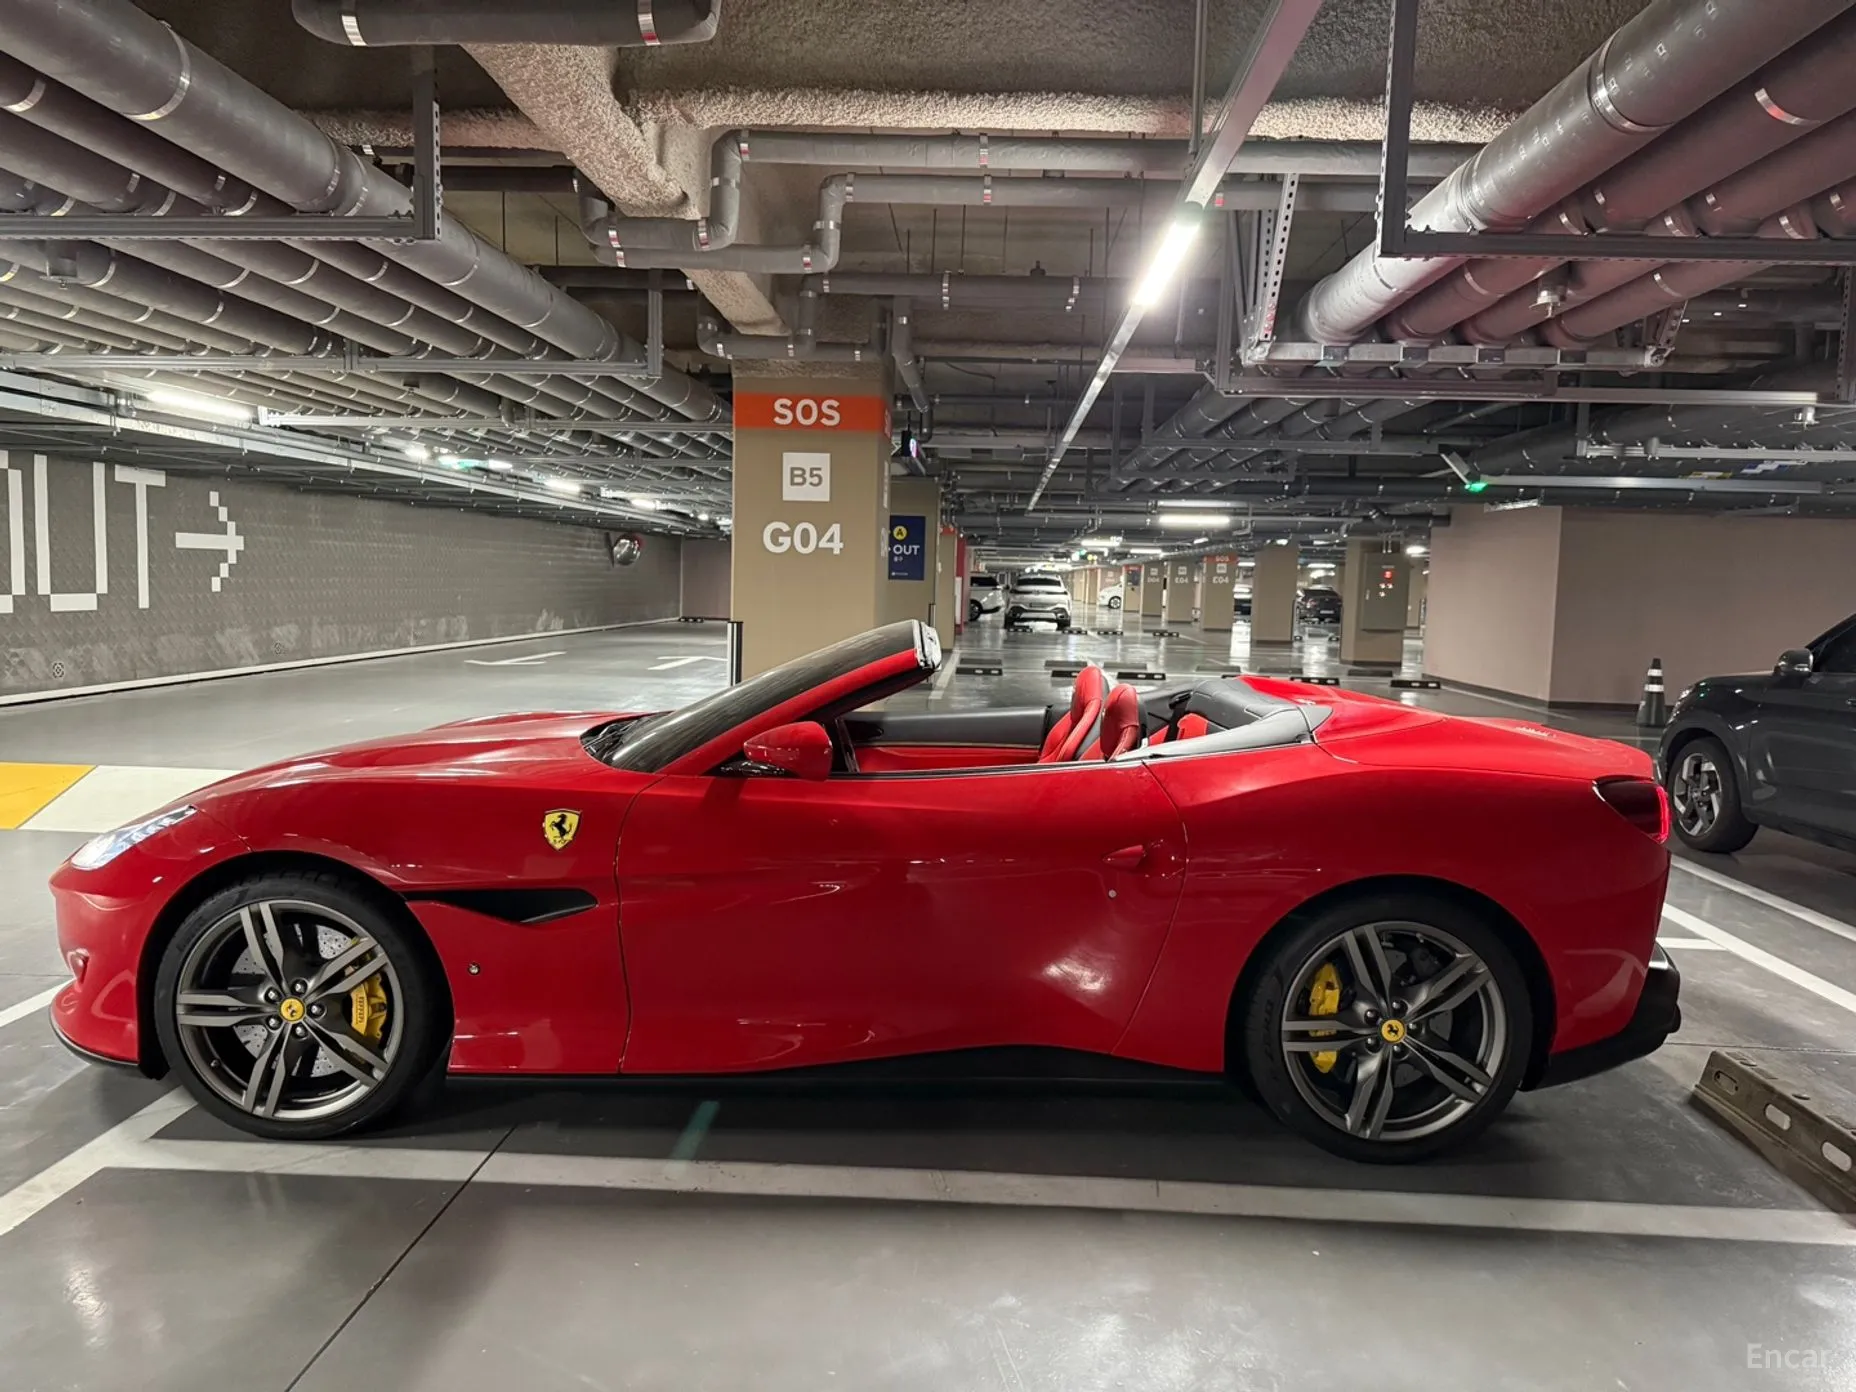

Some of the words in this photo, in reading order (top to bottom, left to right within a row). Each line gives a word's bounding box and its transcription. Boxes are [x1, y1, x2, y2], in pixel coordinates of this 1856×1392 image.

[773, 398, 841, 426] SOS
[789, 466, 823, 487] B5
[762, 521, 844, 555] G04
[893, 544, 920, 555] OUT
